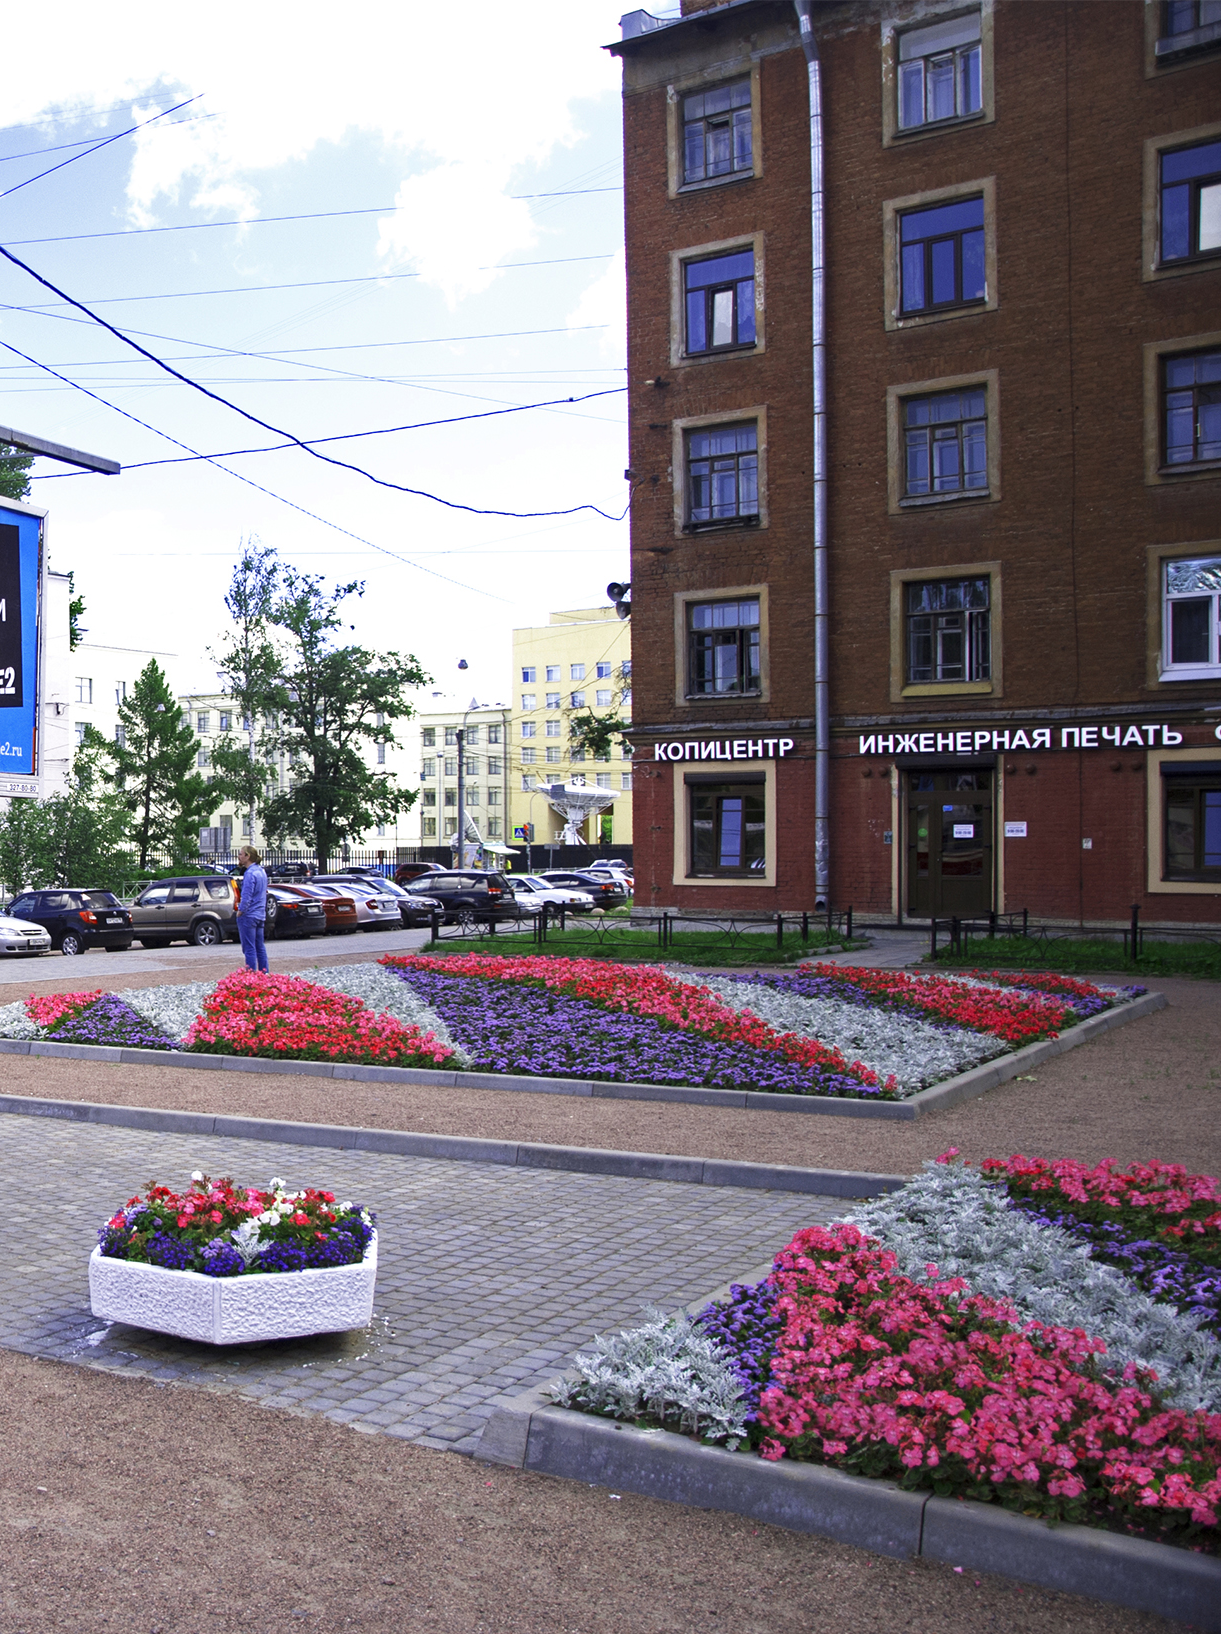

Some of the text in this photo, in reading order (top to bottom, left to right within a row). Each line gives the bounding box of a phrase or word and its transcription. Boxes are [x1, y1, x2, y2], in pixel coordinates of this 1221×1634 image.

[654, 738, 795, 761] КОПИЦЕНТР
[858, 724, 1183, 754] ИНЖЕНЕРНАЯ ПЕЧАТЬ
